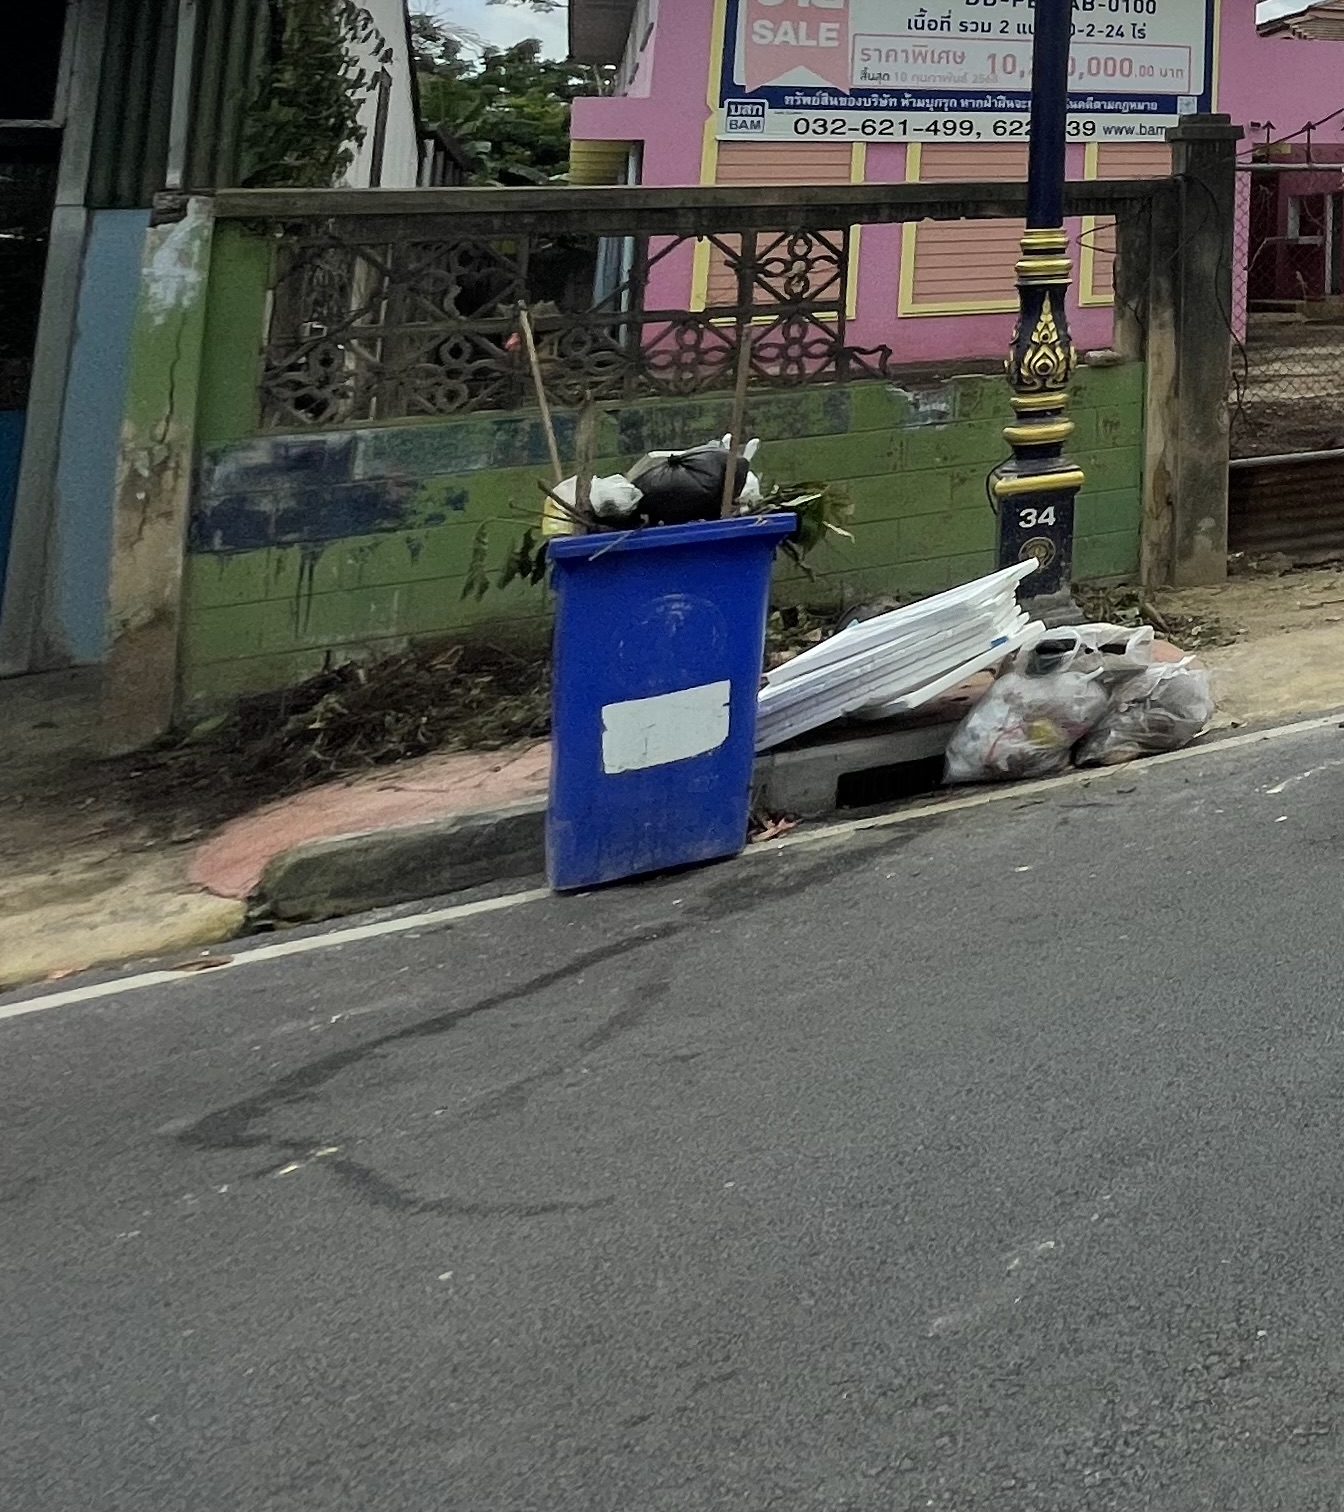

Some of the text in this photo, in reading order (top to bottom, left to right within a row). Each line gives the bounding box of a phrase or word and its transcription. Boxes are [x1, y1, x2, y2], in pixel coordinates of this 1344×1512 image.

[751, 19, 841, 47] SALE
[907, 7, 953, 32] เนื้อที่
[958, 20, 992, 34] รวม
[999, 19, 1010, 34] 2
[1130, 21, 1147, 40] ไร่
[860, 44, 966, 66] ราคาพิเศษ
[1159, 67, 1185, 80] บาท
[728, 103, 763, 117] บสก
[728, 119, 763, 131] BAM
[793, 117, 982, 139] 032-621-499,
[1019, 506, 1056, 528] 34
